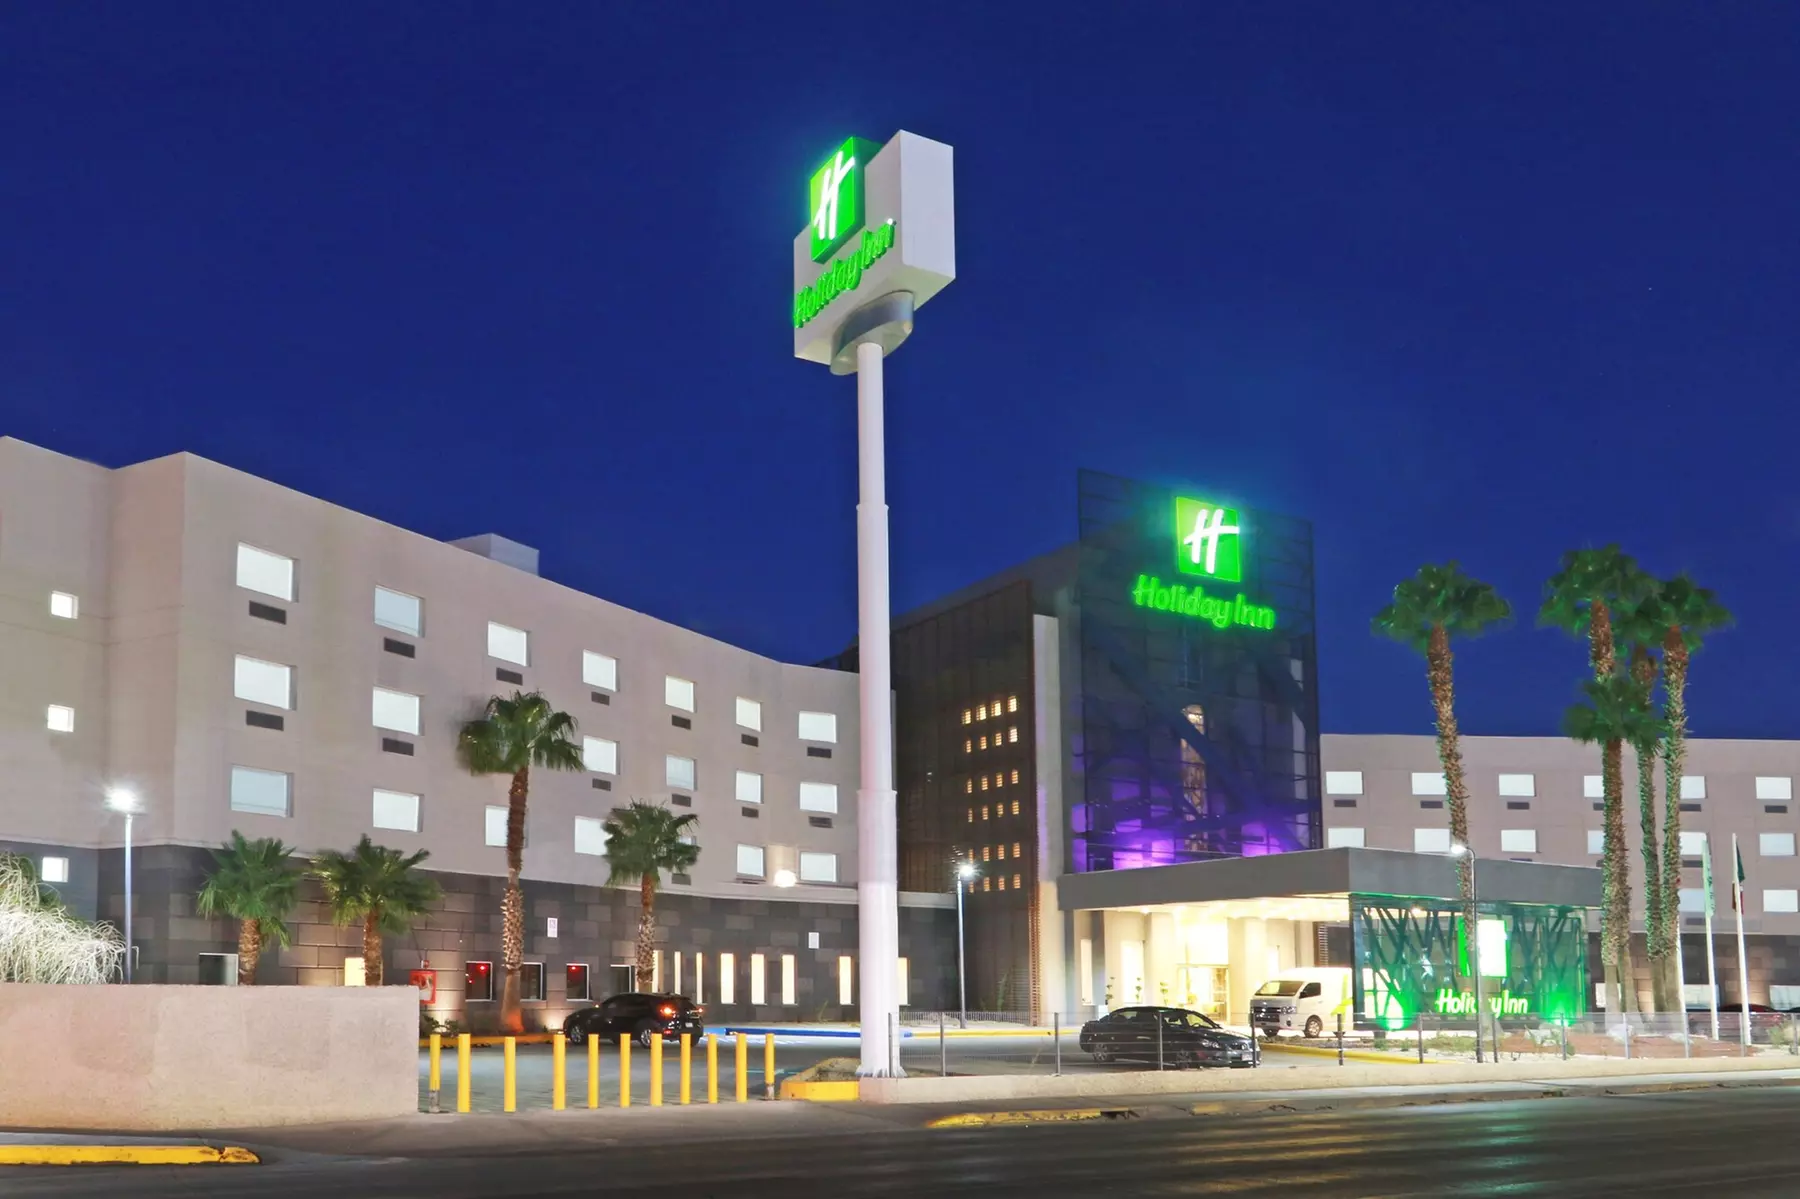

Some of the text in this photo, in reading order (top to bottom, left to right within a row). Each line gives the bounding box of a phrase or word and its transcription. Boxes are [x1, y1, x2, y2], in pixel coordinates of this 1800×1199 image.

[794, 222, 895, 328] Holiday Inn
[1132, 574, 1275, 630] Holiday Inn
[1435, 988, 1528, 1018] Holiy Inn
